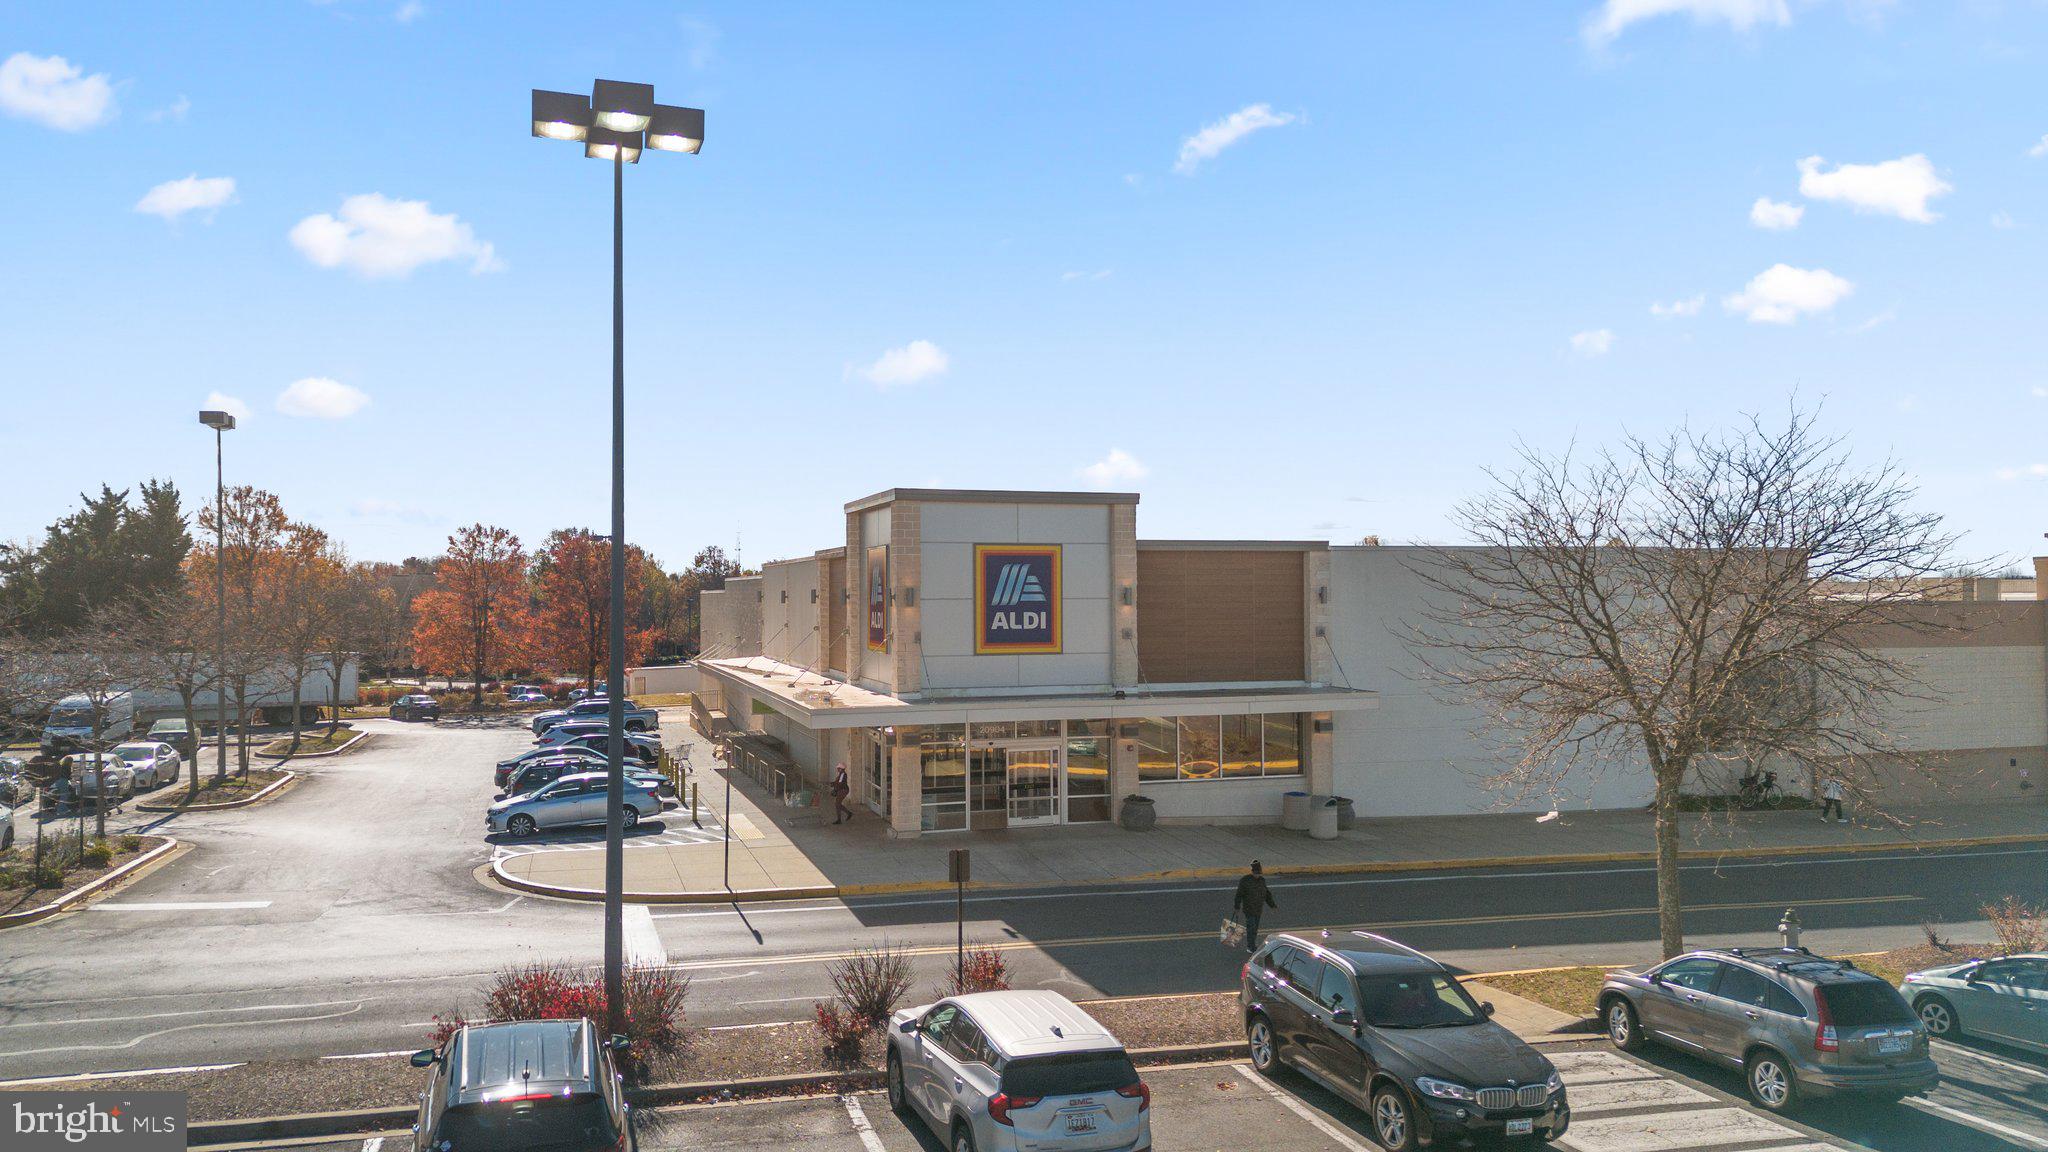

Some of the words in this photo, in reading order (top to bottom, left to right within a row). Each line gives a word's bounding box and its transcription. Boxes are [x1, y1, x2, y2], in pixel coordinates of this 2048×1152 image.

[870, 611, 884, 629] ALDI
[991, 611, 1046, 630] ALDI
[1069, 1097, 1093, 1106] GMC
